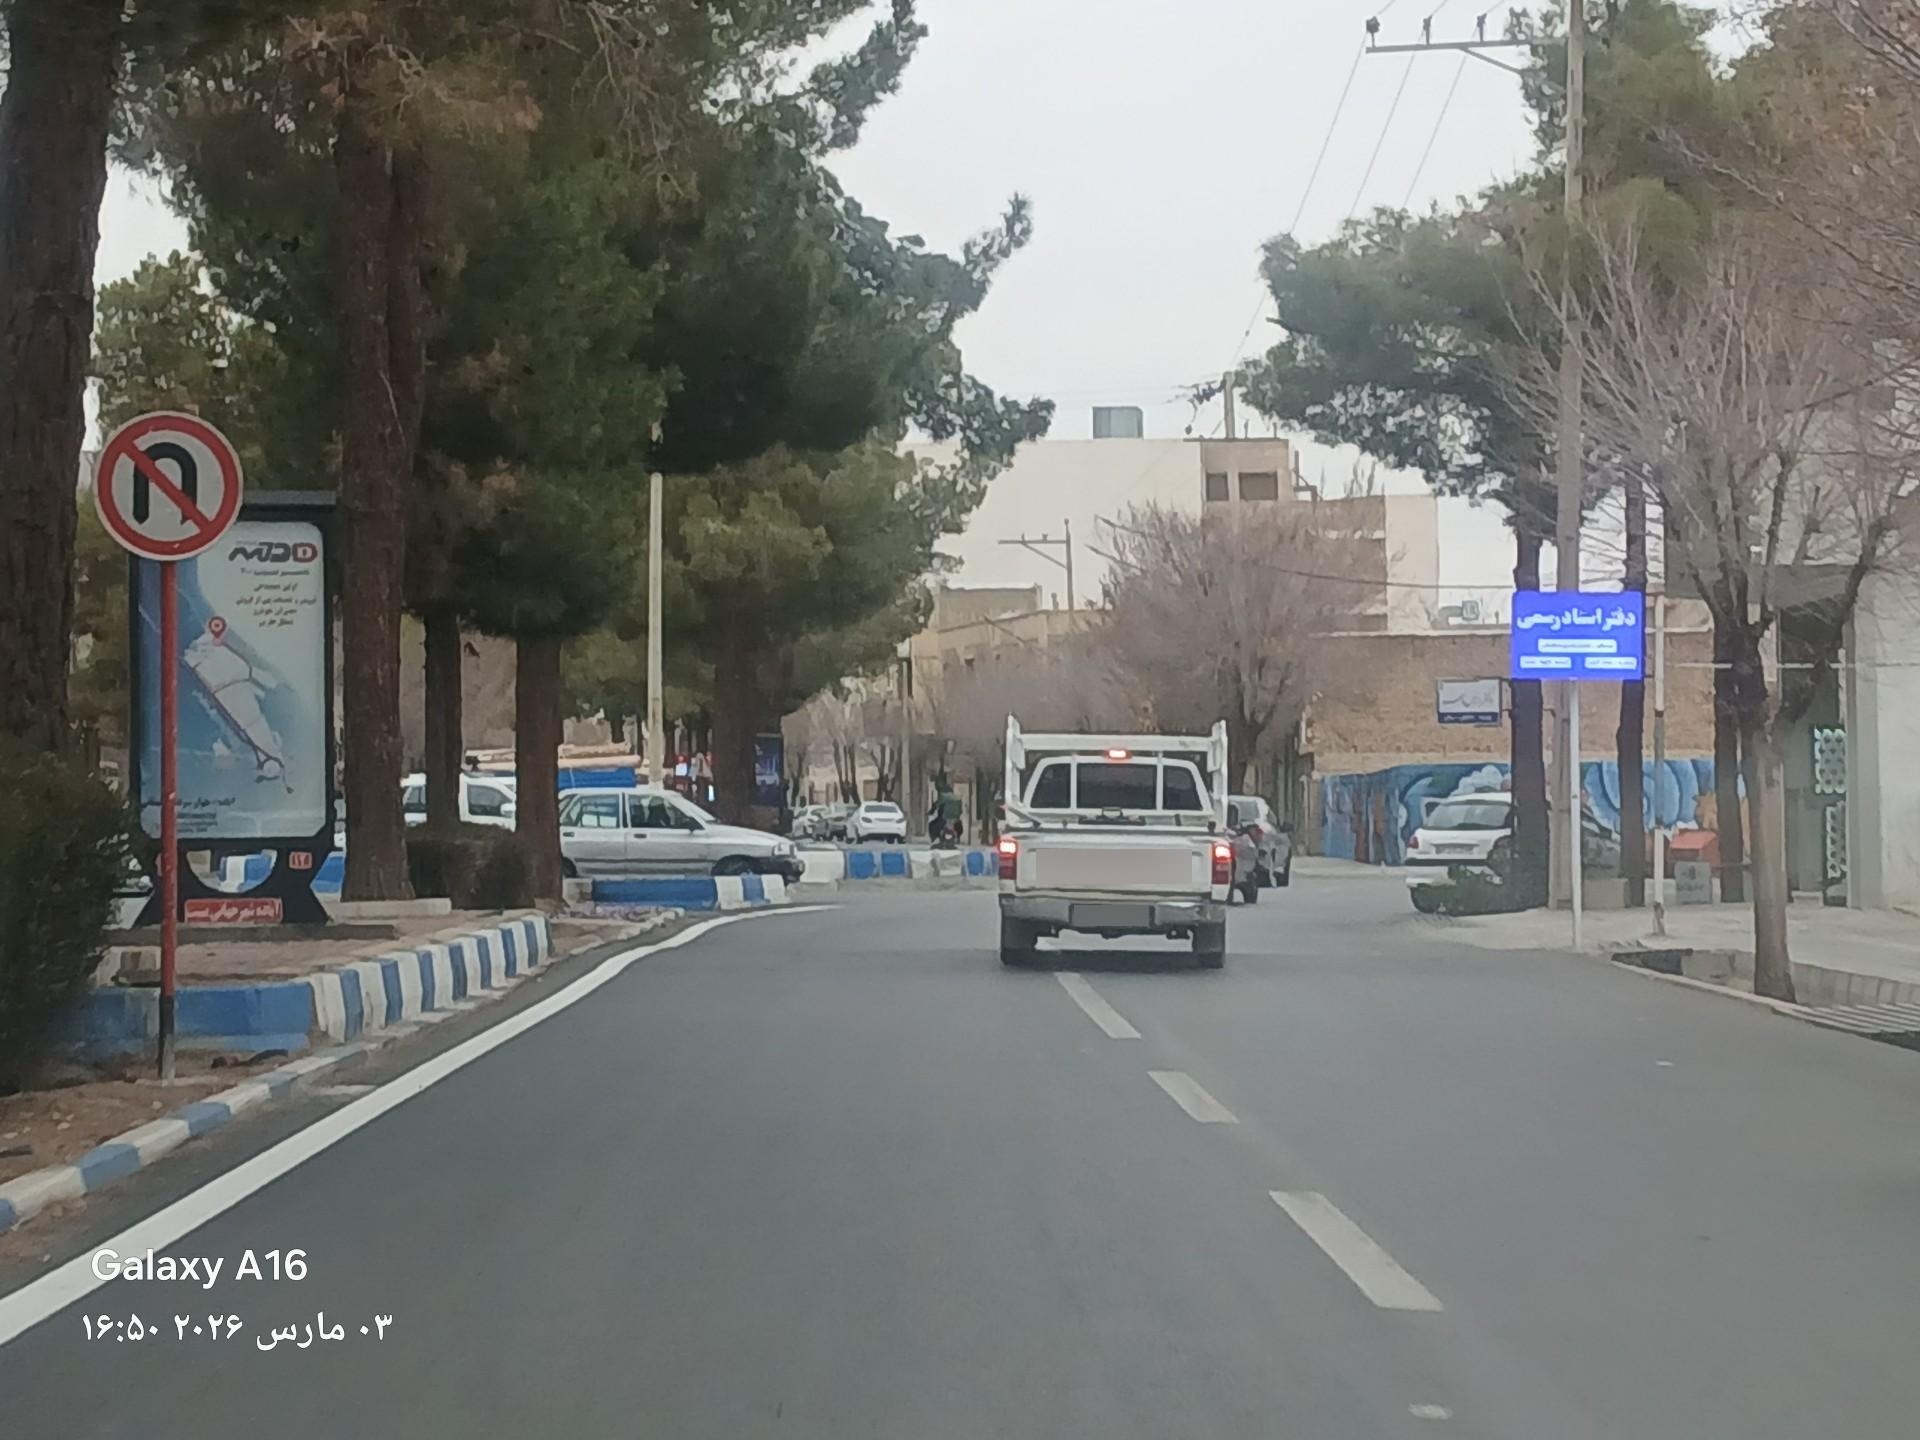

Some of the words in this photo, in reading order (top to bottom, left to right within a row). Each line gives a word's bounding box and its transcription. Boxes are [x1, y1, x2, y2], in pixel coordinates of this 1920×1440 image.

[1516, 613, 1562, 631] رسمی
[1561, 607, 1602, 625] اسناد
[1602, 605, 1636, 632] دفتر
